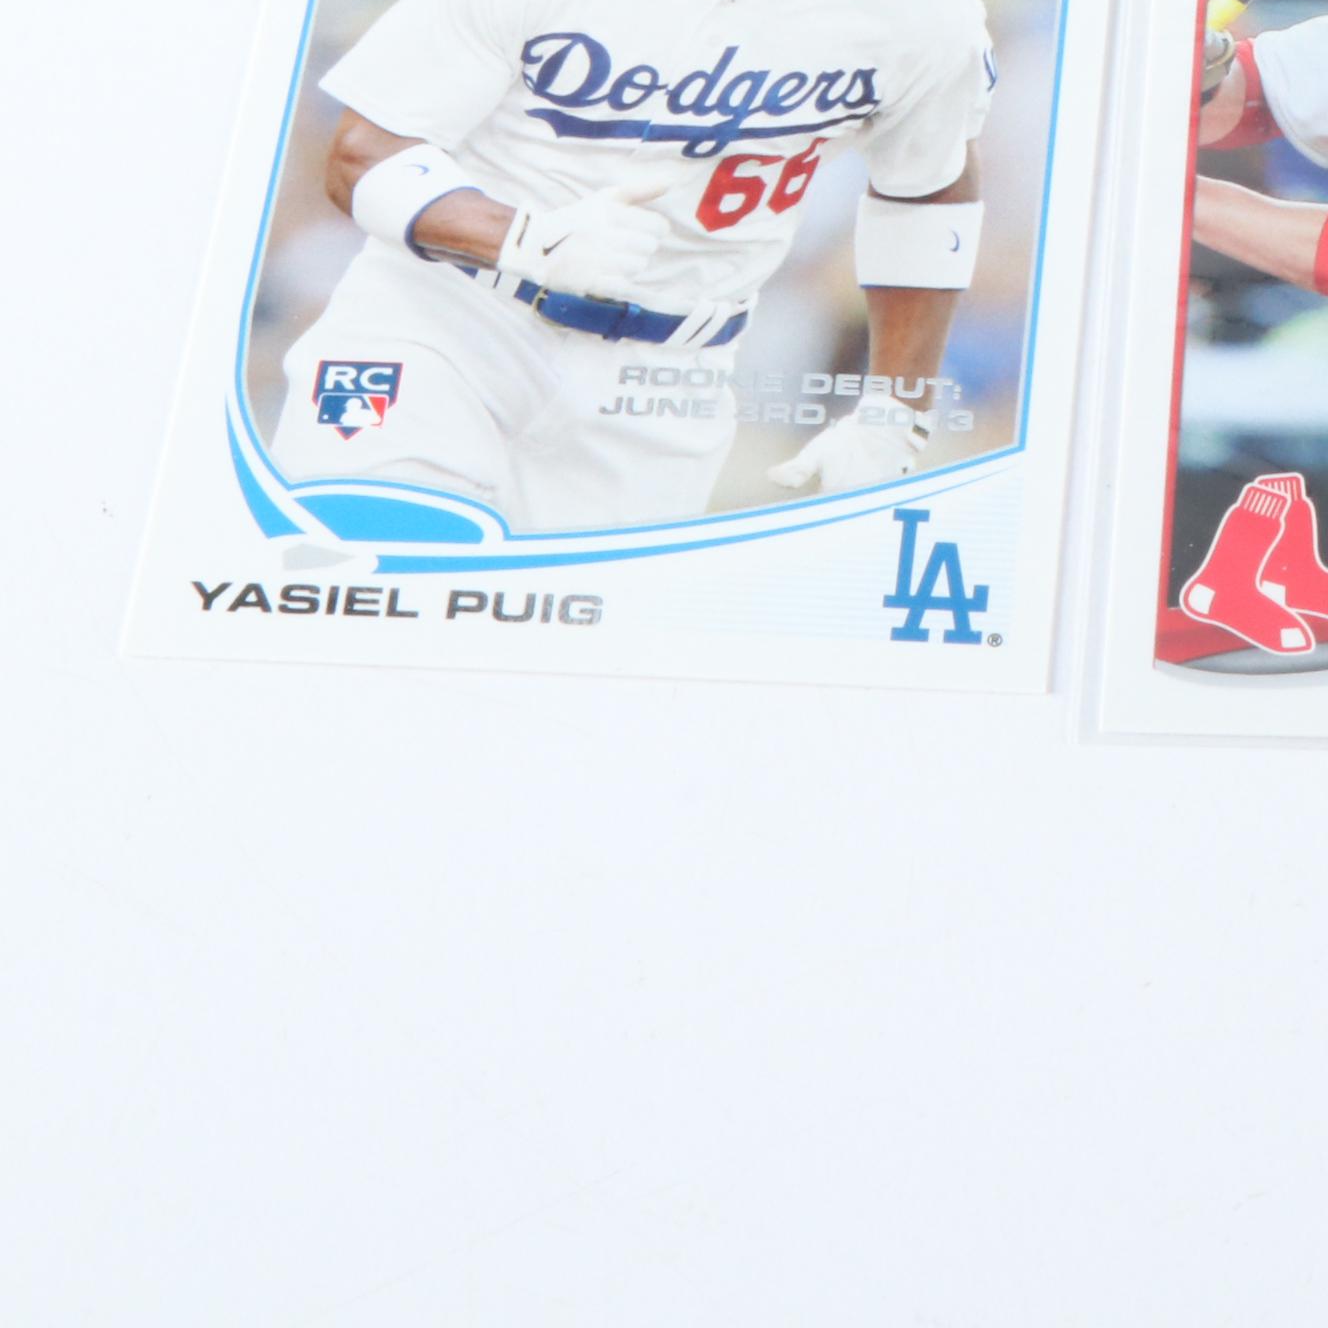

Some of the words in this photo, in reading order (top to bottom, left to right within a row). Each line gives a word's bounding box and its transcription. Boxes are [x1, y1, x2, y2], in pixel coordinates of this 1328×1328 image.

[521, 32, 881, 159] Dodgers
[696, 136, 830, 232] 66
[324, 364, 393, 392] RC
[618, 365, 785, 396] ROOKIE
[800, 372, 962, 401] DEBUT:
[598, 395, 719, 419] JUNE
[883, 508, 989, 645] LA
[191, 580, 419, 620] YASIEL
[444, 588, 605, 626] PUIG
